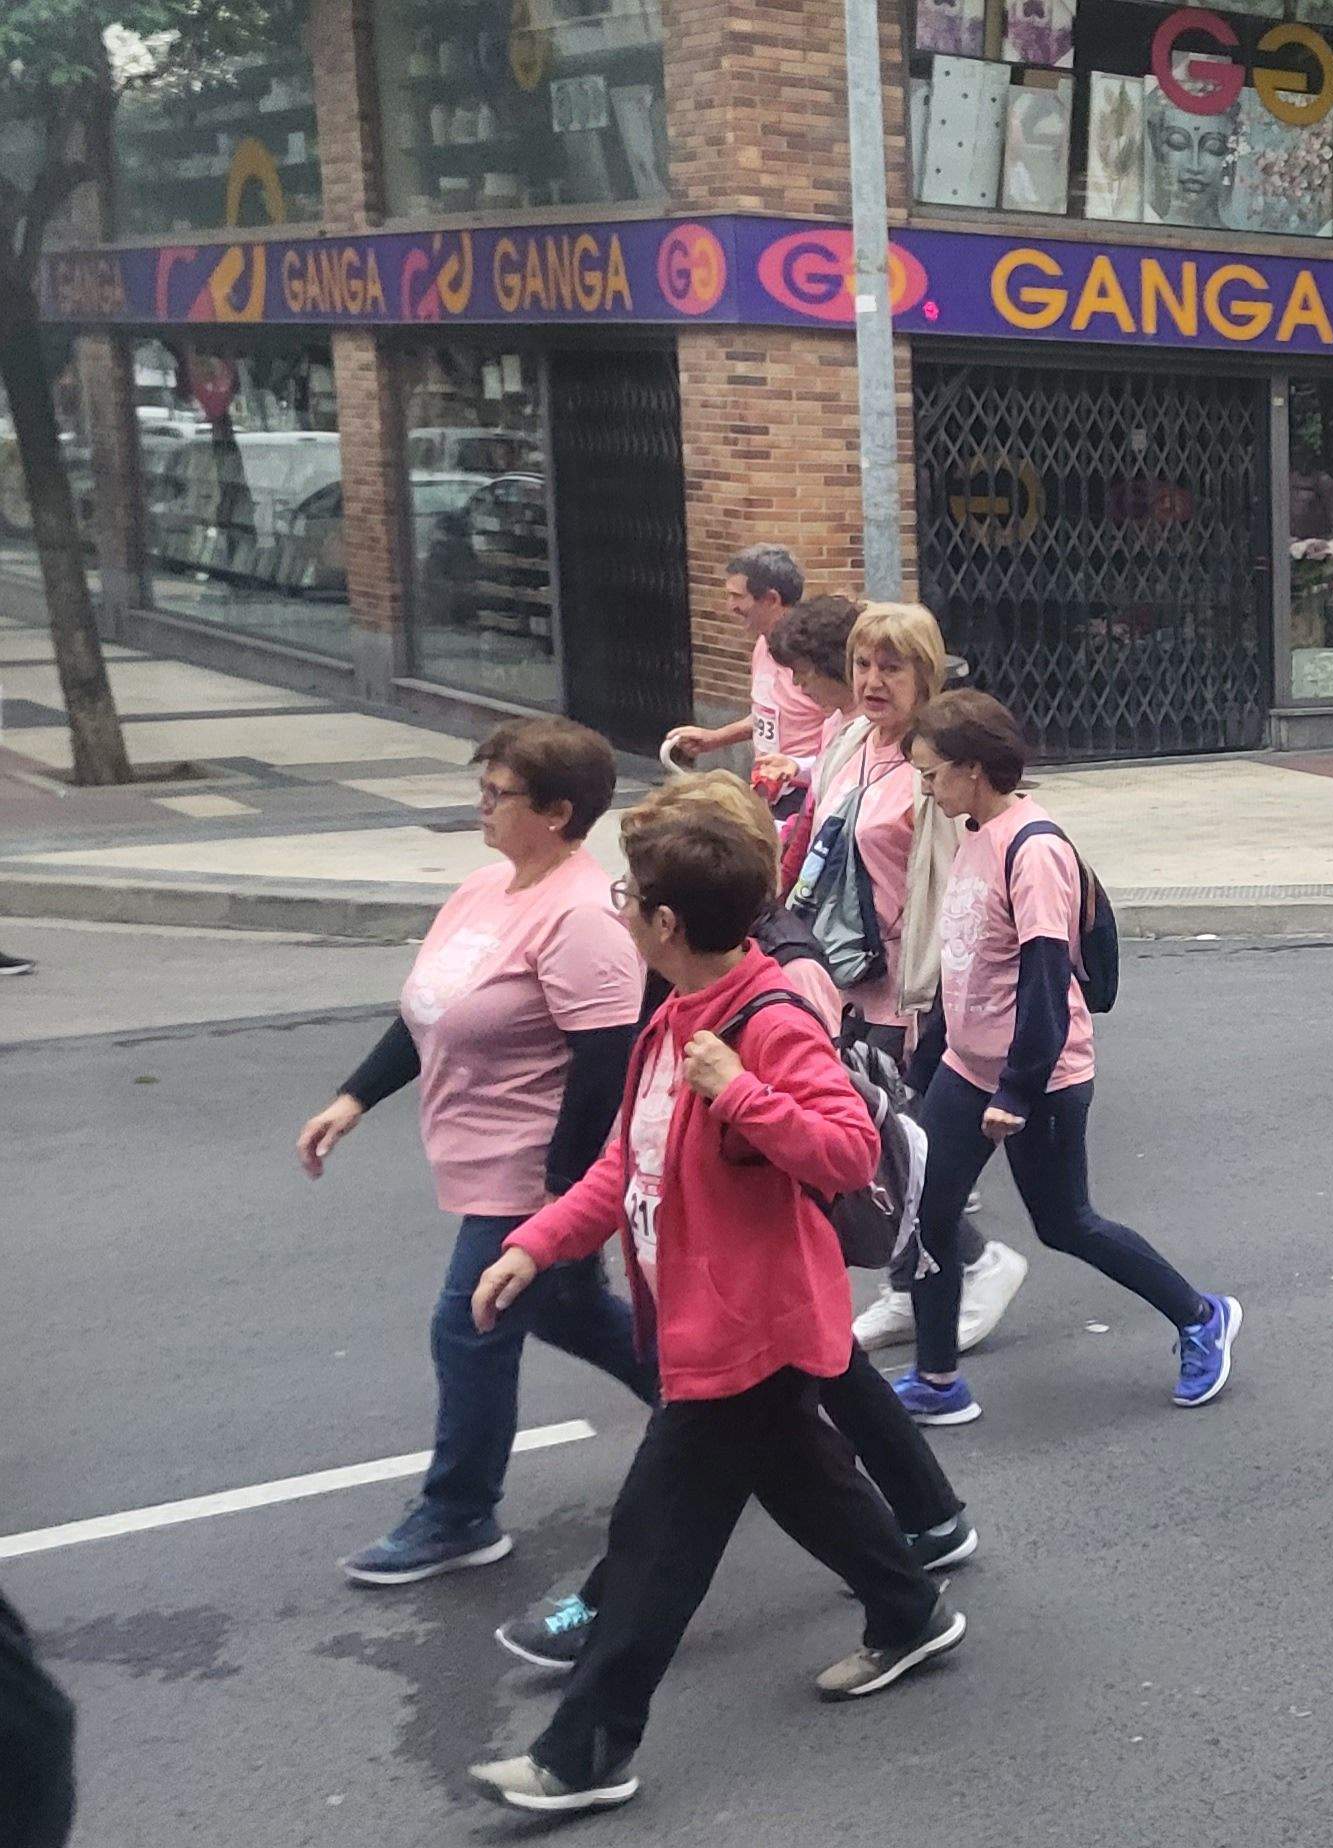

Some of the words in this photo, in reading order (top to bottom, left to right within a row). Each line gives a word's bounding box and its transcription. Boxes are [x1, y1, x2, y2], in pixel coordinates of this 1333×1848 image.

[282, 246, 387, 315] GANGA
[492, 232, 633, 313] GANGA
[753, 716, 775, 740] 93
